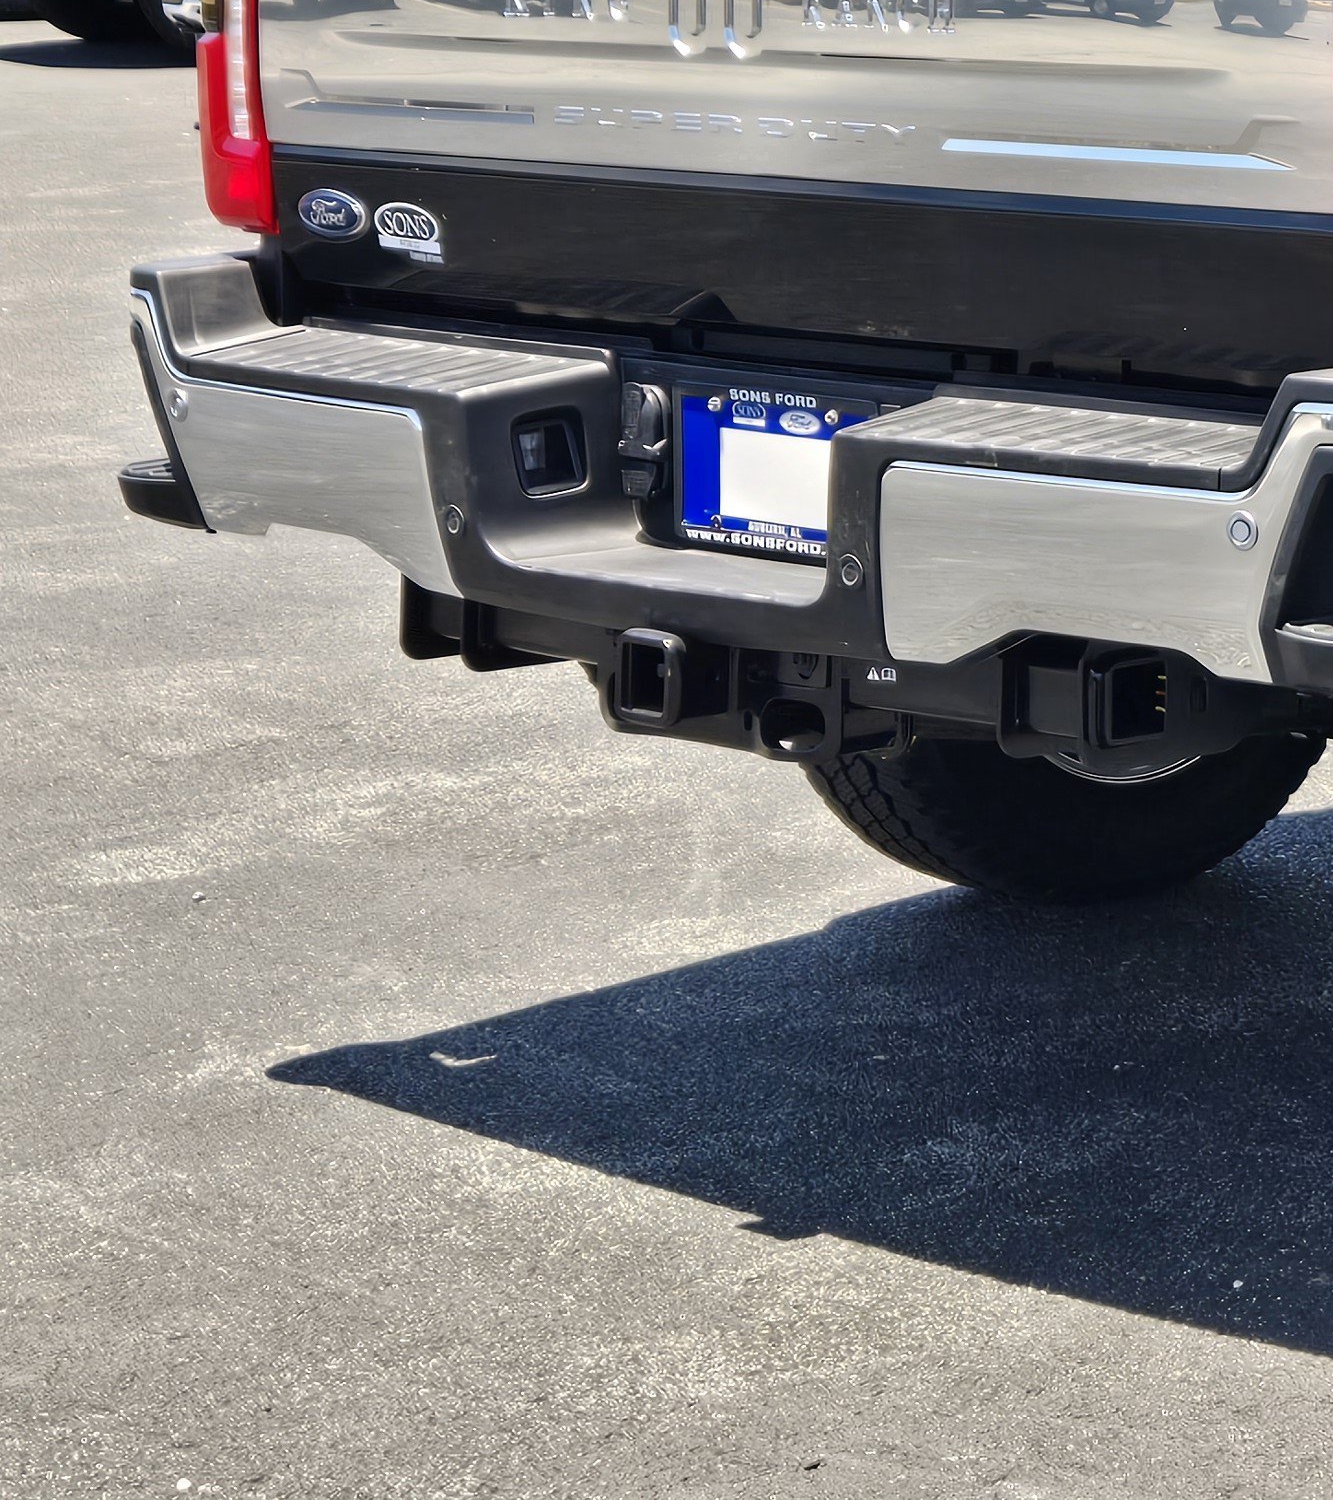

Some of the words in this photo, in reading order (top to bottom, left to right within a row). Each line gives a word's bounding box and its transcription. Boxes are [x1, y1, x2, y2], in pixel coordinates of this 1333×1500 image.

[553, 105, 743, 135] SUPER
[757, 116, 916, 143] DUTY
[310, 198, 347, 226] Ford
[383, 210, 429, 239] SONS
[729, 388, 771, 404] SONS
[775, 393, 817, 408] FORD
